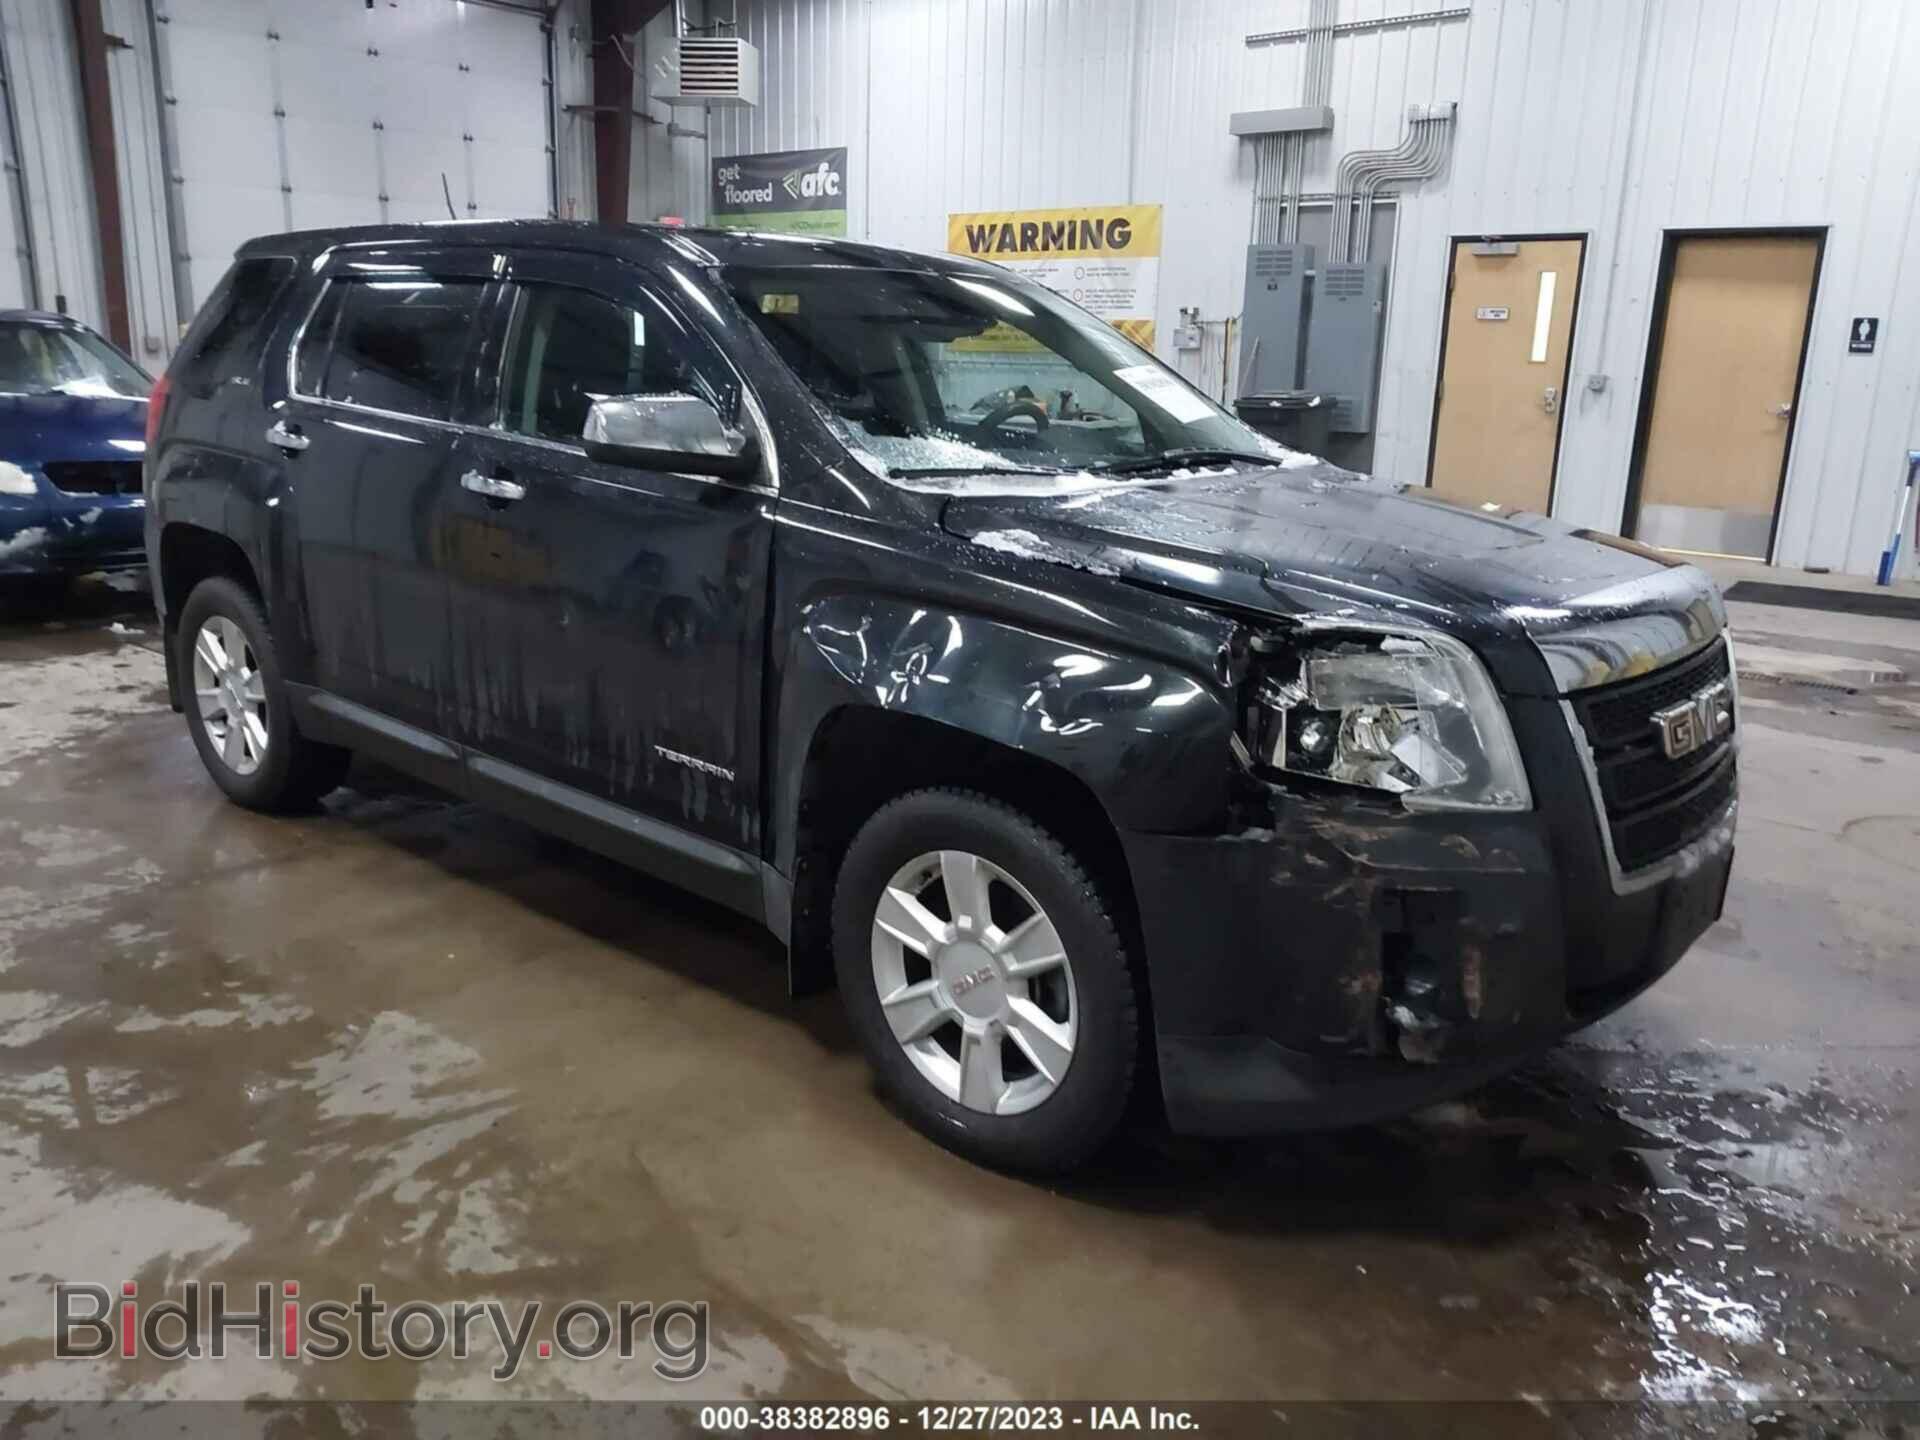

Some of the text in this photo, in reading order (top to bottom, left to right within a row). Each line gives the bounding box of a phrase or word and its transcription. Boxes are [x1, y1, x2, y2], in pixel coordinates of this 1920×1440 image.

[718, 163, 741, 187] get
[725, 182, 774, 204] floored
[801, 162, 840, 198] afc
[965, 217, 1132, 254] WARNING
[1662, 683, 1730, 760] GMC
